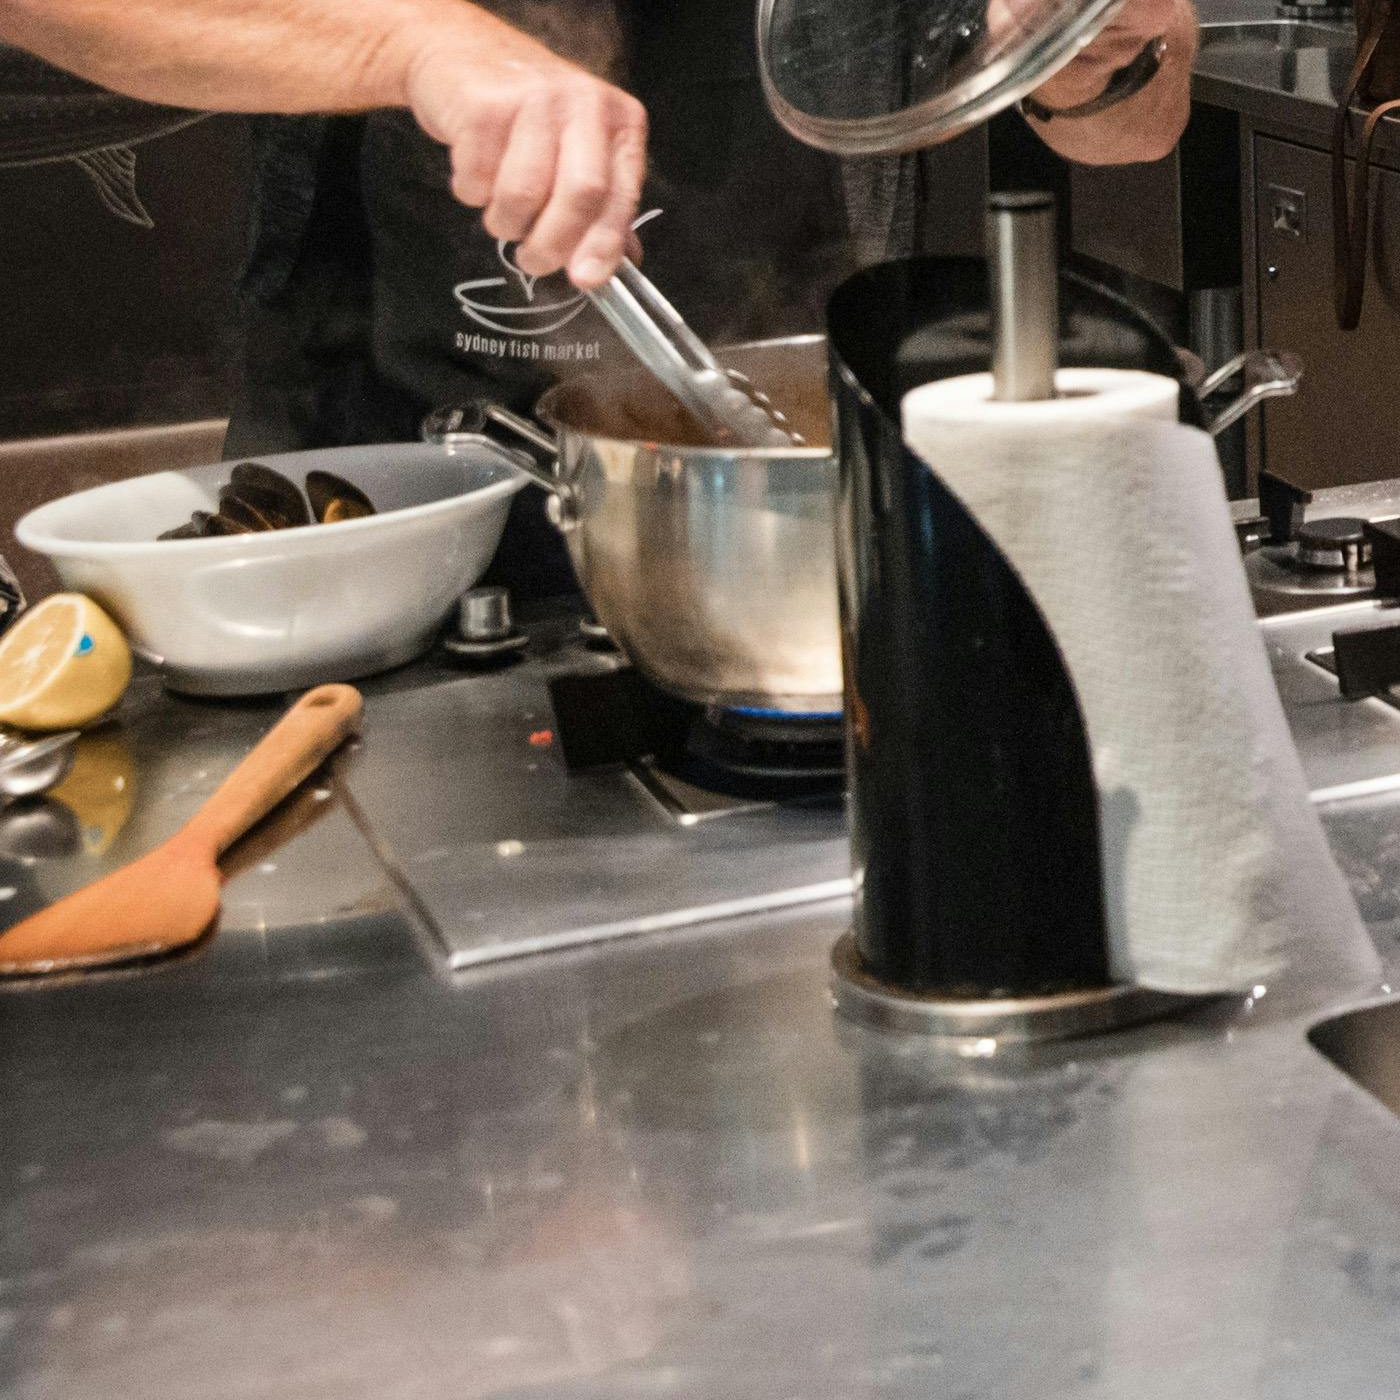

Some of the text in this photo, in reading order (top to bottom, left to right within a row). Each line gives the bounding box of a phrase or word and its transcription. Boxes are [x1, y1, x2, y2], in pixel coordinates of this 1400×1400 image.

[456, 331, 600, 361] sydney fish market
